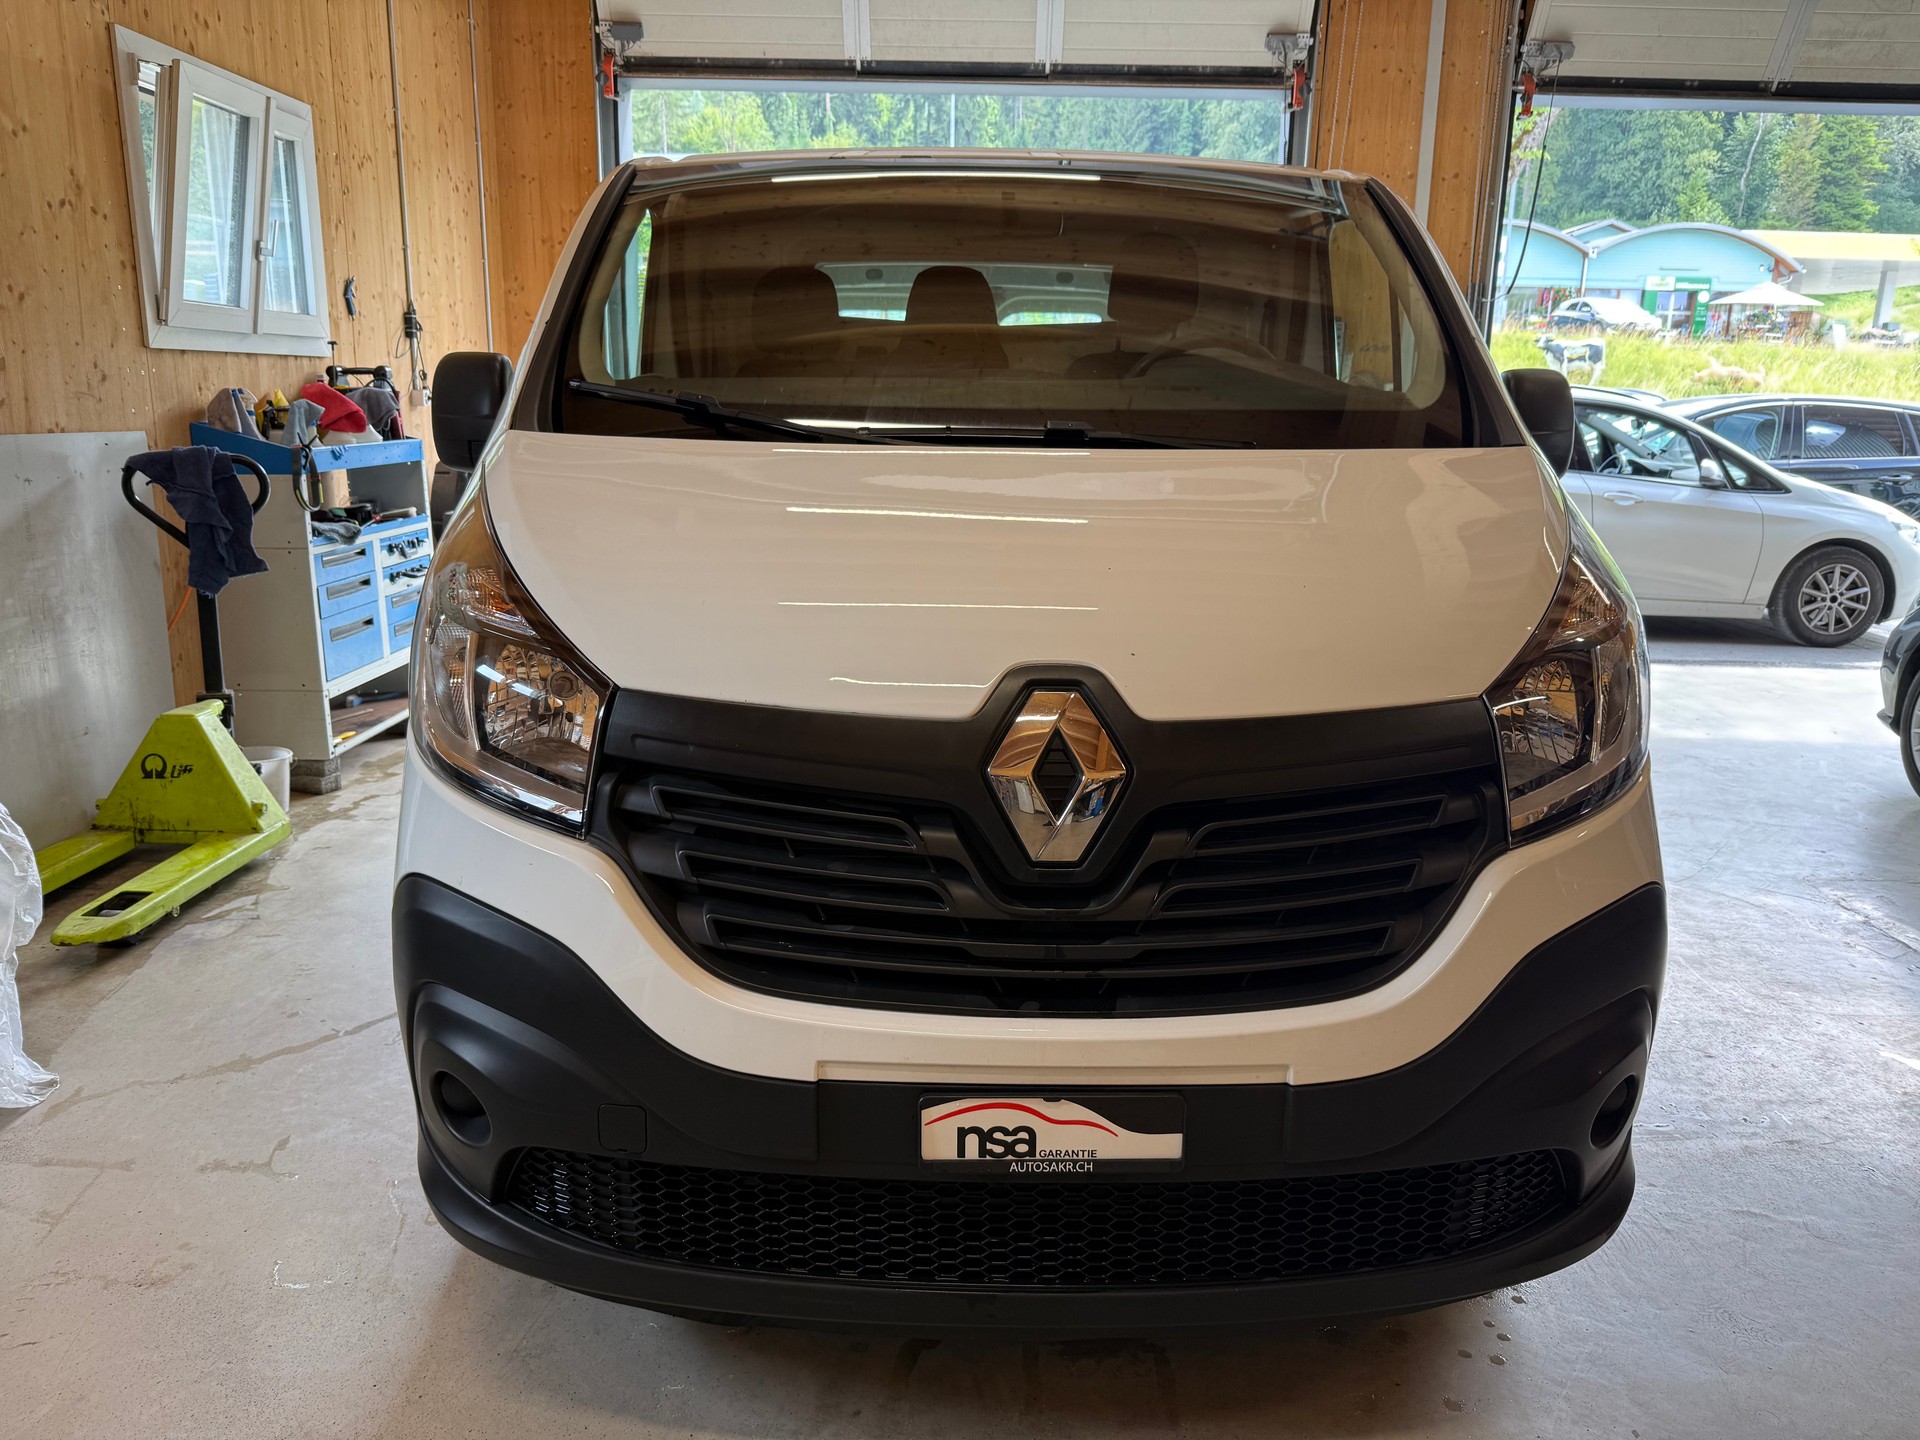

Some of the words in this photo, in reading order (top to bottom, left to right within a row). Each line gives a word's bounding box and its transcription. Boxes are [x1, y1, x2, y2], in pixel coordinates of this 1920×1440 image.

[957, 1125, 1037, 1158] nsa
[1038, 1149, 1098, 1159] GARANTIE
[1009, 1161, 1094, 1173] AUTOSAKR.CH
